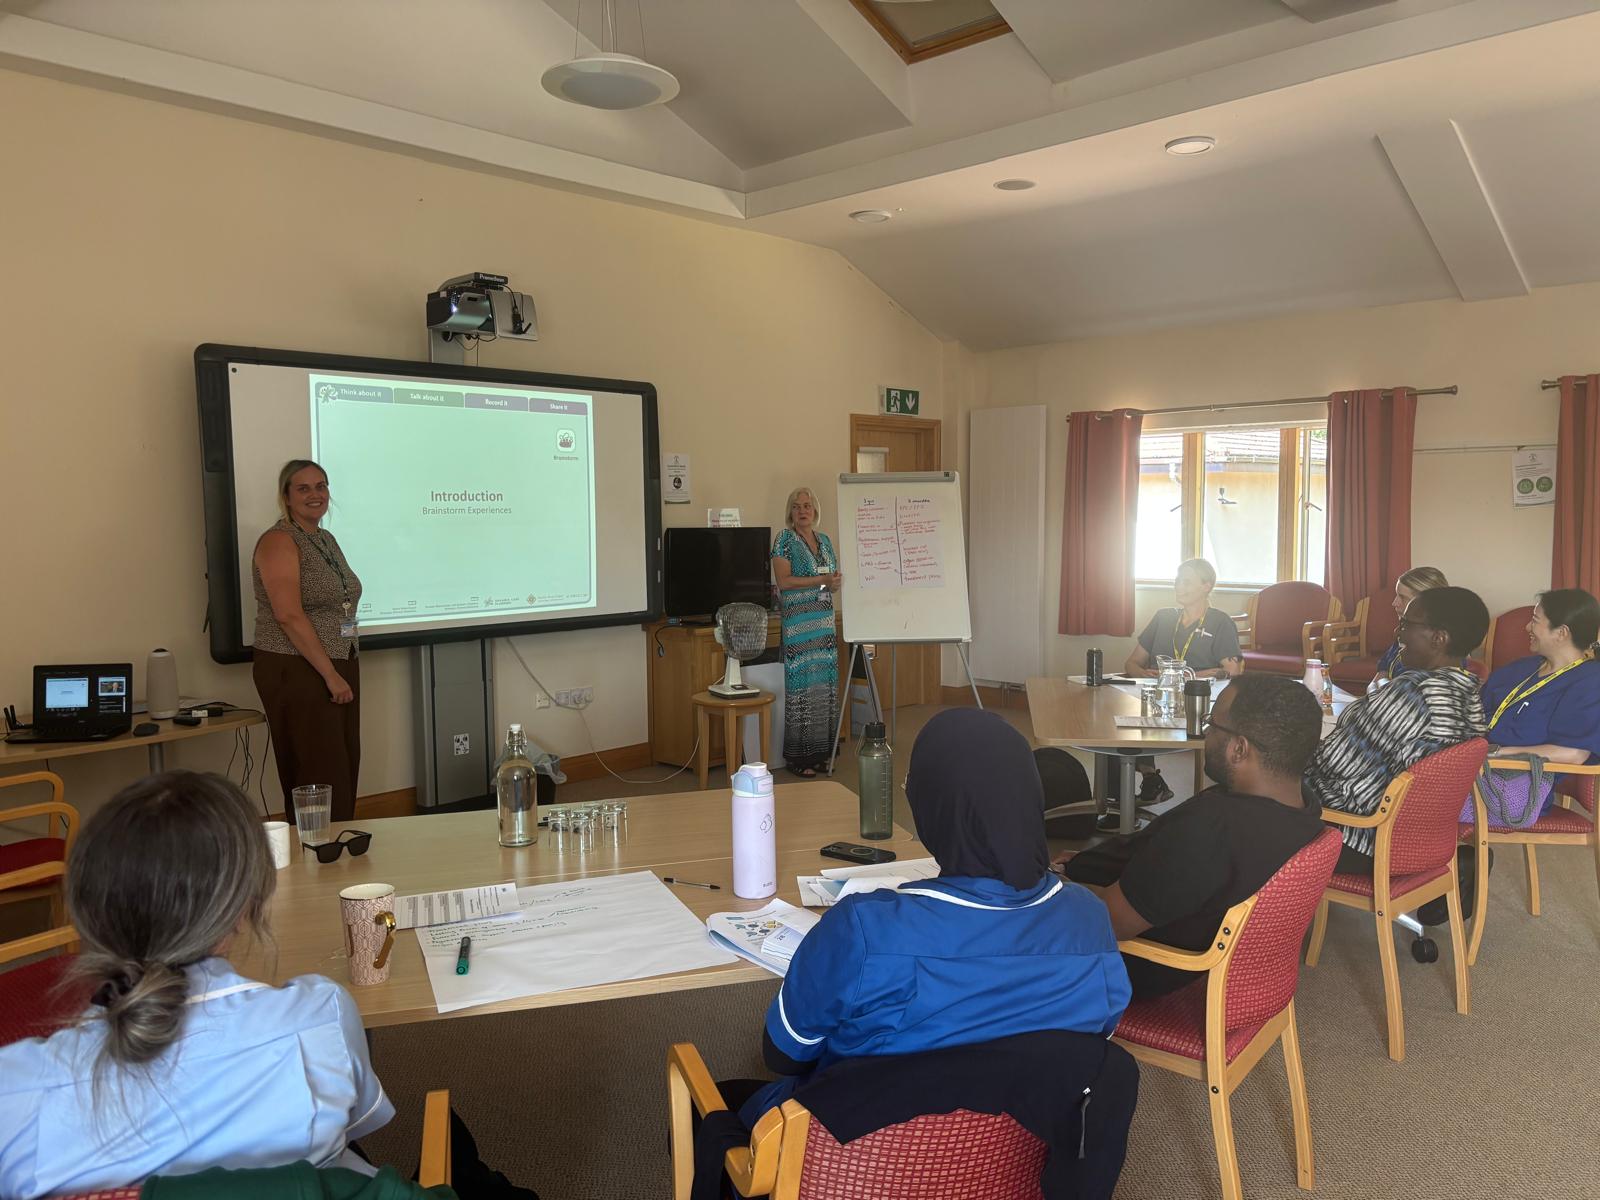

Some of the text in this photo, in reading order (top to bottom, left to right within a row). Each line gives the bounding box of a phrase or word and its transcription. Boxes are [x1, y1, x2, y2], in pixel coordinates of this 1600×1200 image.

[340, 388, 357, 396] Think
[358, 389, 376, 397] about
[423, 394, 439, 402] about
[431, 489, 503, 502] Introduction
[422, 506, 512, 516] Brainstorm Experiences
